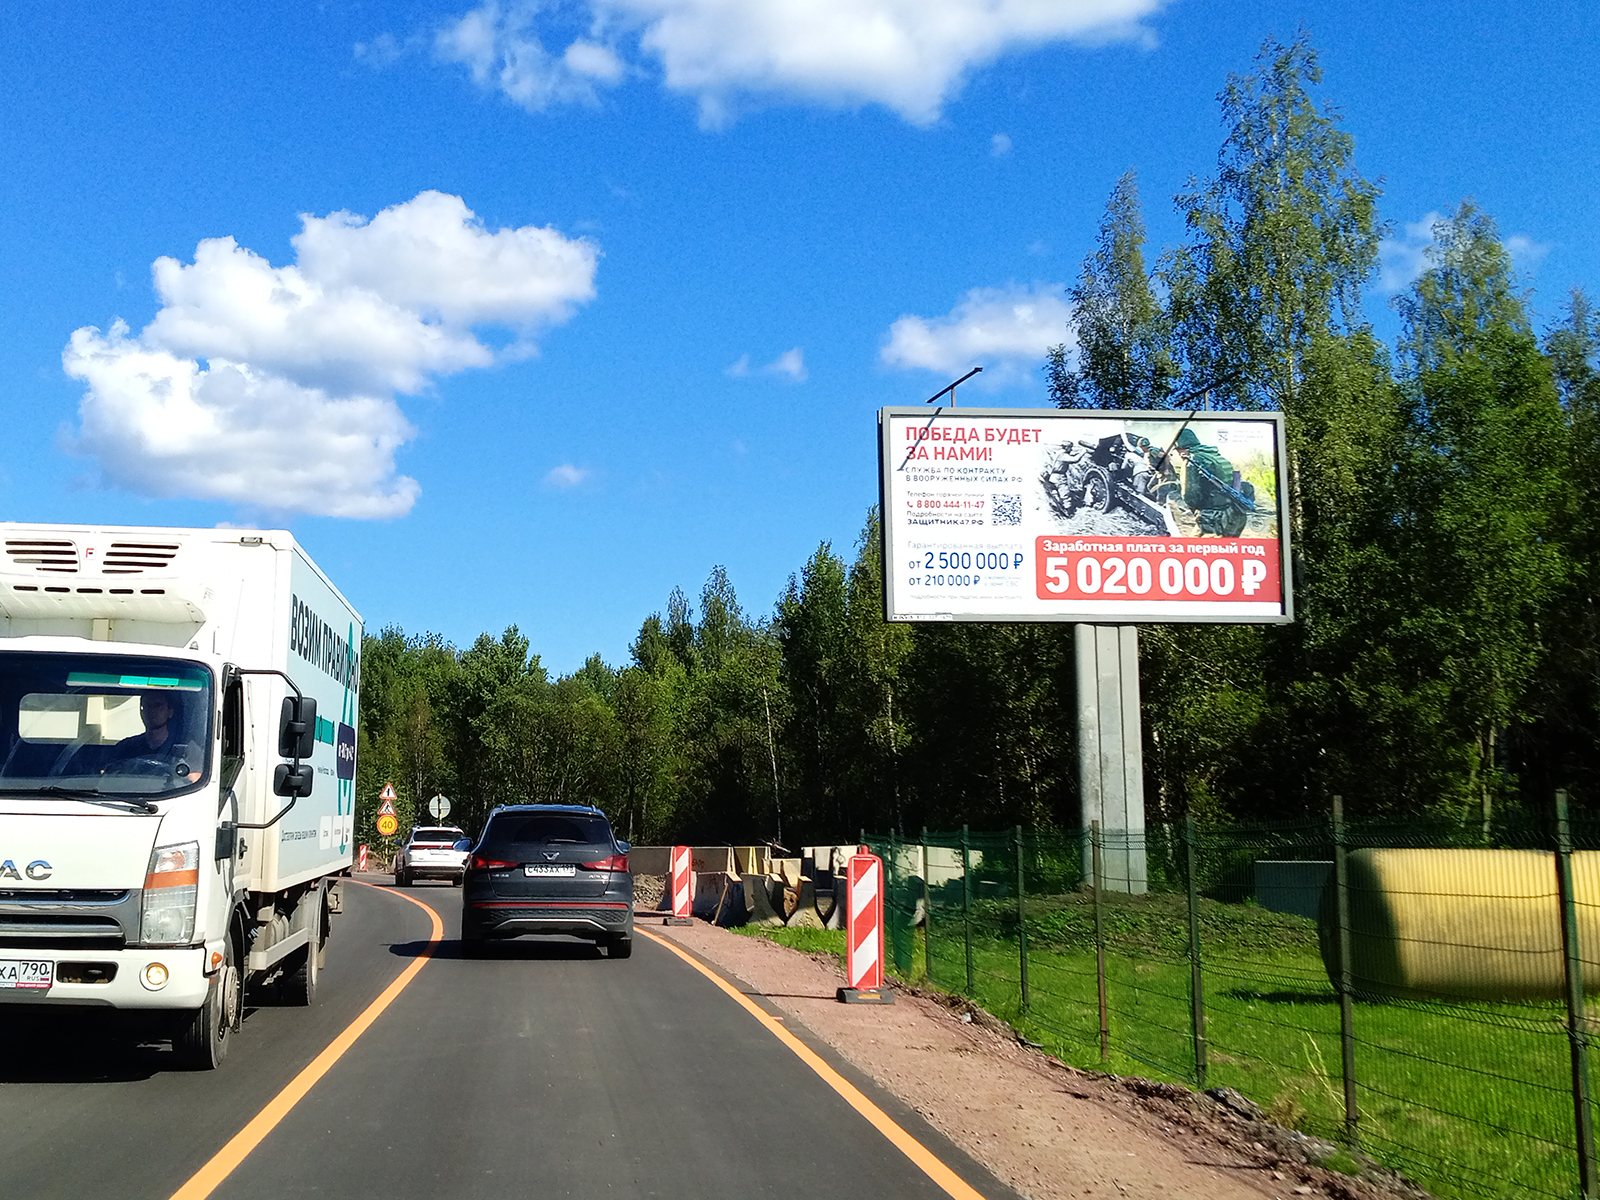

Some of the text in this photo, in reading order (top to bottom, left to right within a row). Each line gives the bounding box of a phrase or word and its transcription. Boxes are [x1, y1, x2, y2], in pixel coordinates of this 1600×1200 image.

[905, 427, 1042, 445] ПОБЕДА БУДЕТ
[905, 446, 993, 461] ЗА НАМИ!
[957, 467, 1006, 475] КОНТРАКТУ
[913, 475, 978, 483] ВООРУЖЕННЫХ
[916, 500, 985, 509] 8 800 444-11-47
[1043, 540, 1265, 556] Заработная плата за первый год
[908, 561, 922, 569] от
[908, 577, 922, 586] от
[924, 575, 945, 586] 210
[947, 575, 971, 586] 000
[1076, 557, 1152, 595] 020
[1159, 557, 1235, 596] 000
[290, 593, 322, 669] ВОЗИМ
[381, 821, 393, 829] 40
[21, 963, 48, 976] 790
